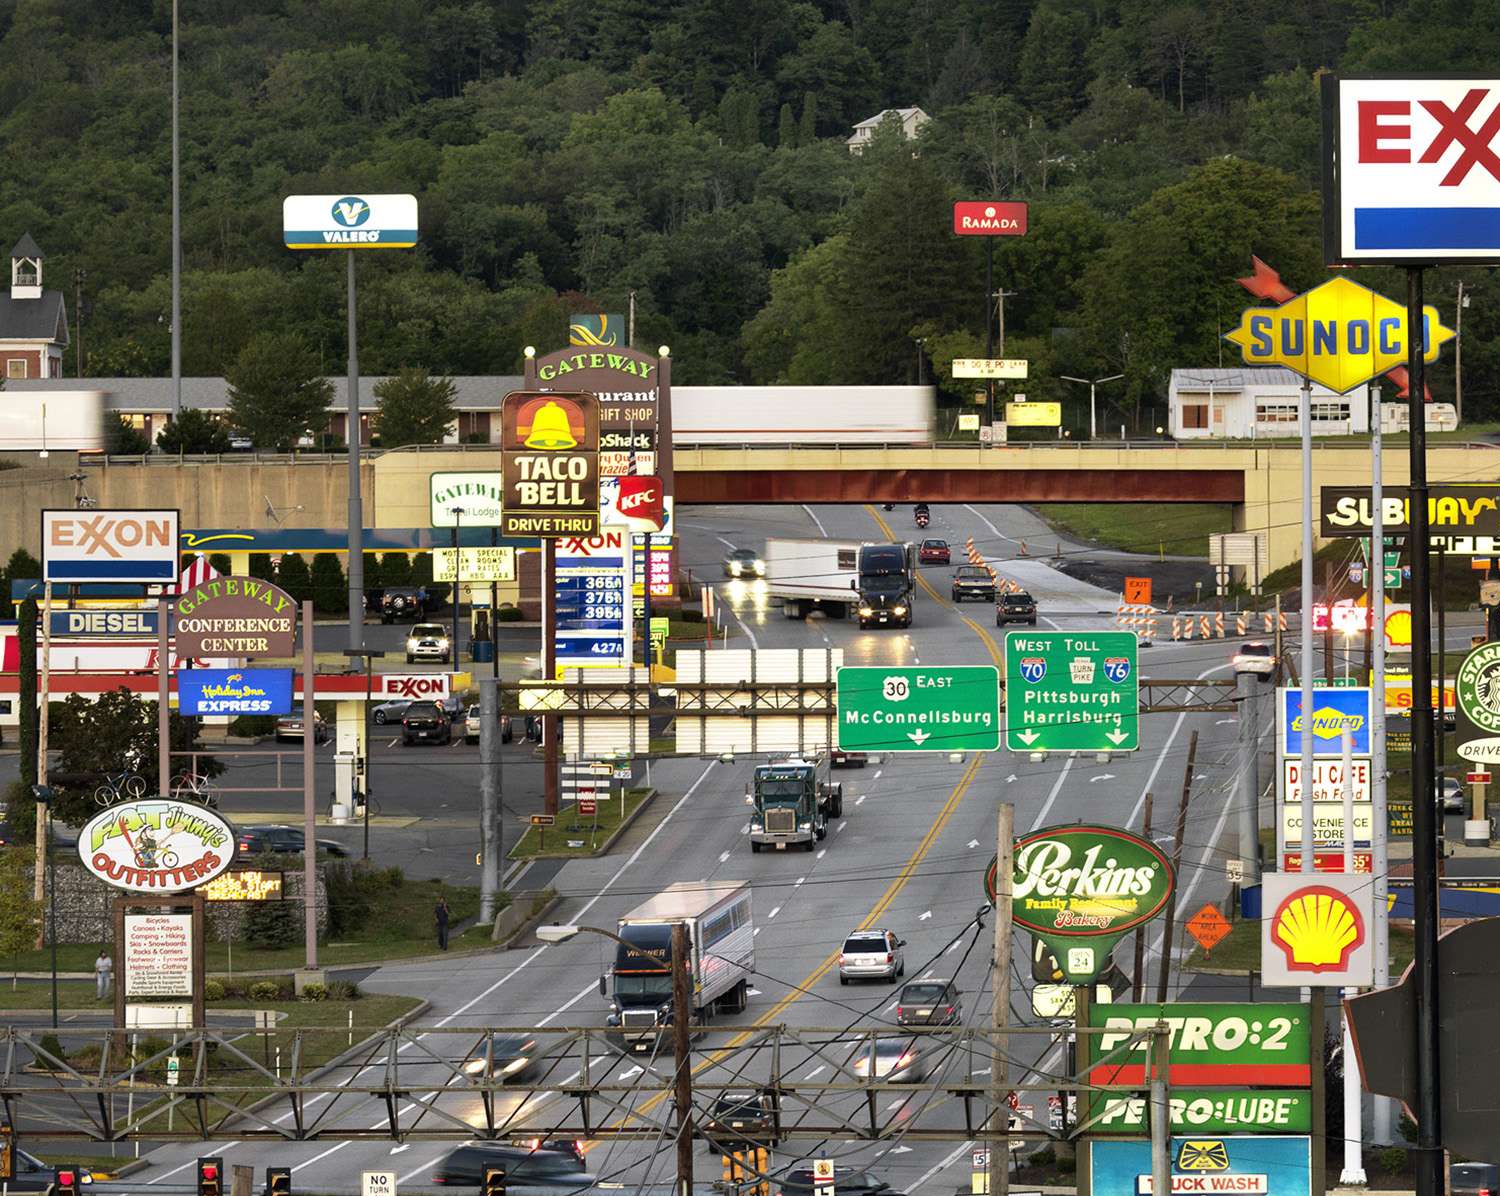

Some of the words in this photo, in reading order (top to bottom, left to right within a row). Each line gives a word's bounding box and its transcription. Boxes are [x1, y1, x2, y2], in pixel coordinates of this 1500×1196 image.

[961, 215, 1019, 230] RAMADA
[322, 231, 380, 243] VALERO
[1249, 314, 1432, 357] SUNOC
[539, 353, 655, 381] GATEWAY
[625, 408, 653, 421] SHOP
[514, 456, 588, 481] TACO
[514, 481, 586, 506] BELL
[621, 489, 656, 510] KFC
[472, 508, 500, 518] Lodge
[508, 519, 551, 532] DRIVE
[552, 519, 592, 532] THRU
[51, 515, 170, 558] EXXON
[178, 579, 290, 617] GATEWAY
[69, 613, 153, 633] DIESEL
[178, 617, 291, 633] CONFERENCE
[200, 638, 268, 652] CENTER
[1014, 638, 1052, 652] WEST
[1064, 638, 1101, 652] TOLL
[1022, 662, 1043, 678] 70
[1072, 664, 1093, 673] TURN
[1105, 662, 1127, 678] 76
[1073, 673, 1092, 682] PIKE
[201, 684, 242, 699] Holiday
[243, 685, 265, 696] Inn
[387, 677, 444, 699] EXXON
[886, 681, 906, 697] 30
[916, 675, 953, 689] EAST
[198, 700, 272, 712] EXPRESS
[1024, 690, 1121, 707] Pittsburgh
[845, 710, 992, 727] McConnellsburg
[1024, 710, 1122, 727] Harrisburg
[91, 803, 170, 853] FAT
[165, 805, 229, 849] Jimmy's
[1287, 817, 1369, 828] COVENIECE
[1313, 829, 1345, 839] STORE
[91, 850, 222, 888] OUTFITTERS
[1011, 839, 1155, 900] Perkins
[1230, 871, 1241, 880] 35
[247, 879, 281, 891] START
[1025, 898, 1067, 911] Family
[1054, 909, 1114, 929] Bakery
[161, 925, 184, 933] Kayaks
[130, 933, 159, 941] Camping
[165, 933, 186, 941] Hiking
[1101, 1097, 1293, 1125] PERO:LUBE
[370, 1174, 388, 1186] NO
[1210, 1176, 1260, 1191] WASH
[369, 1185, 389, 1195] TURN
